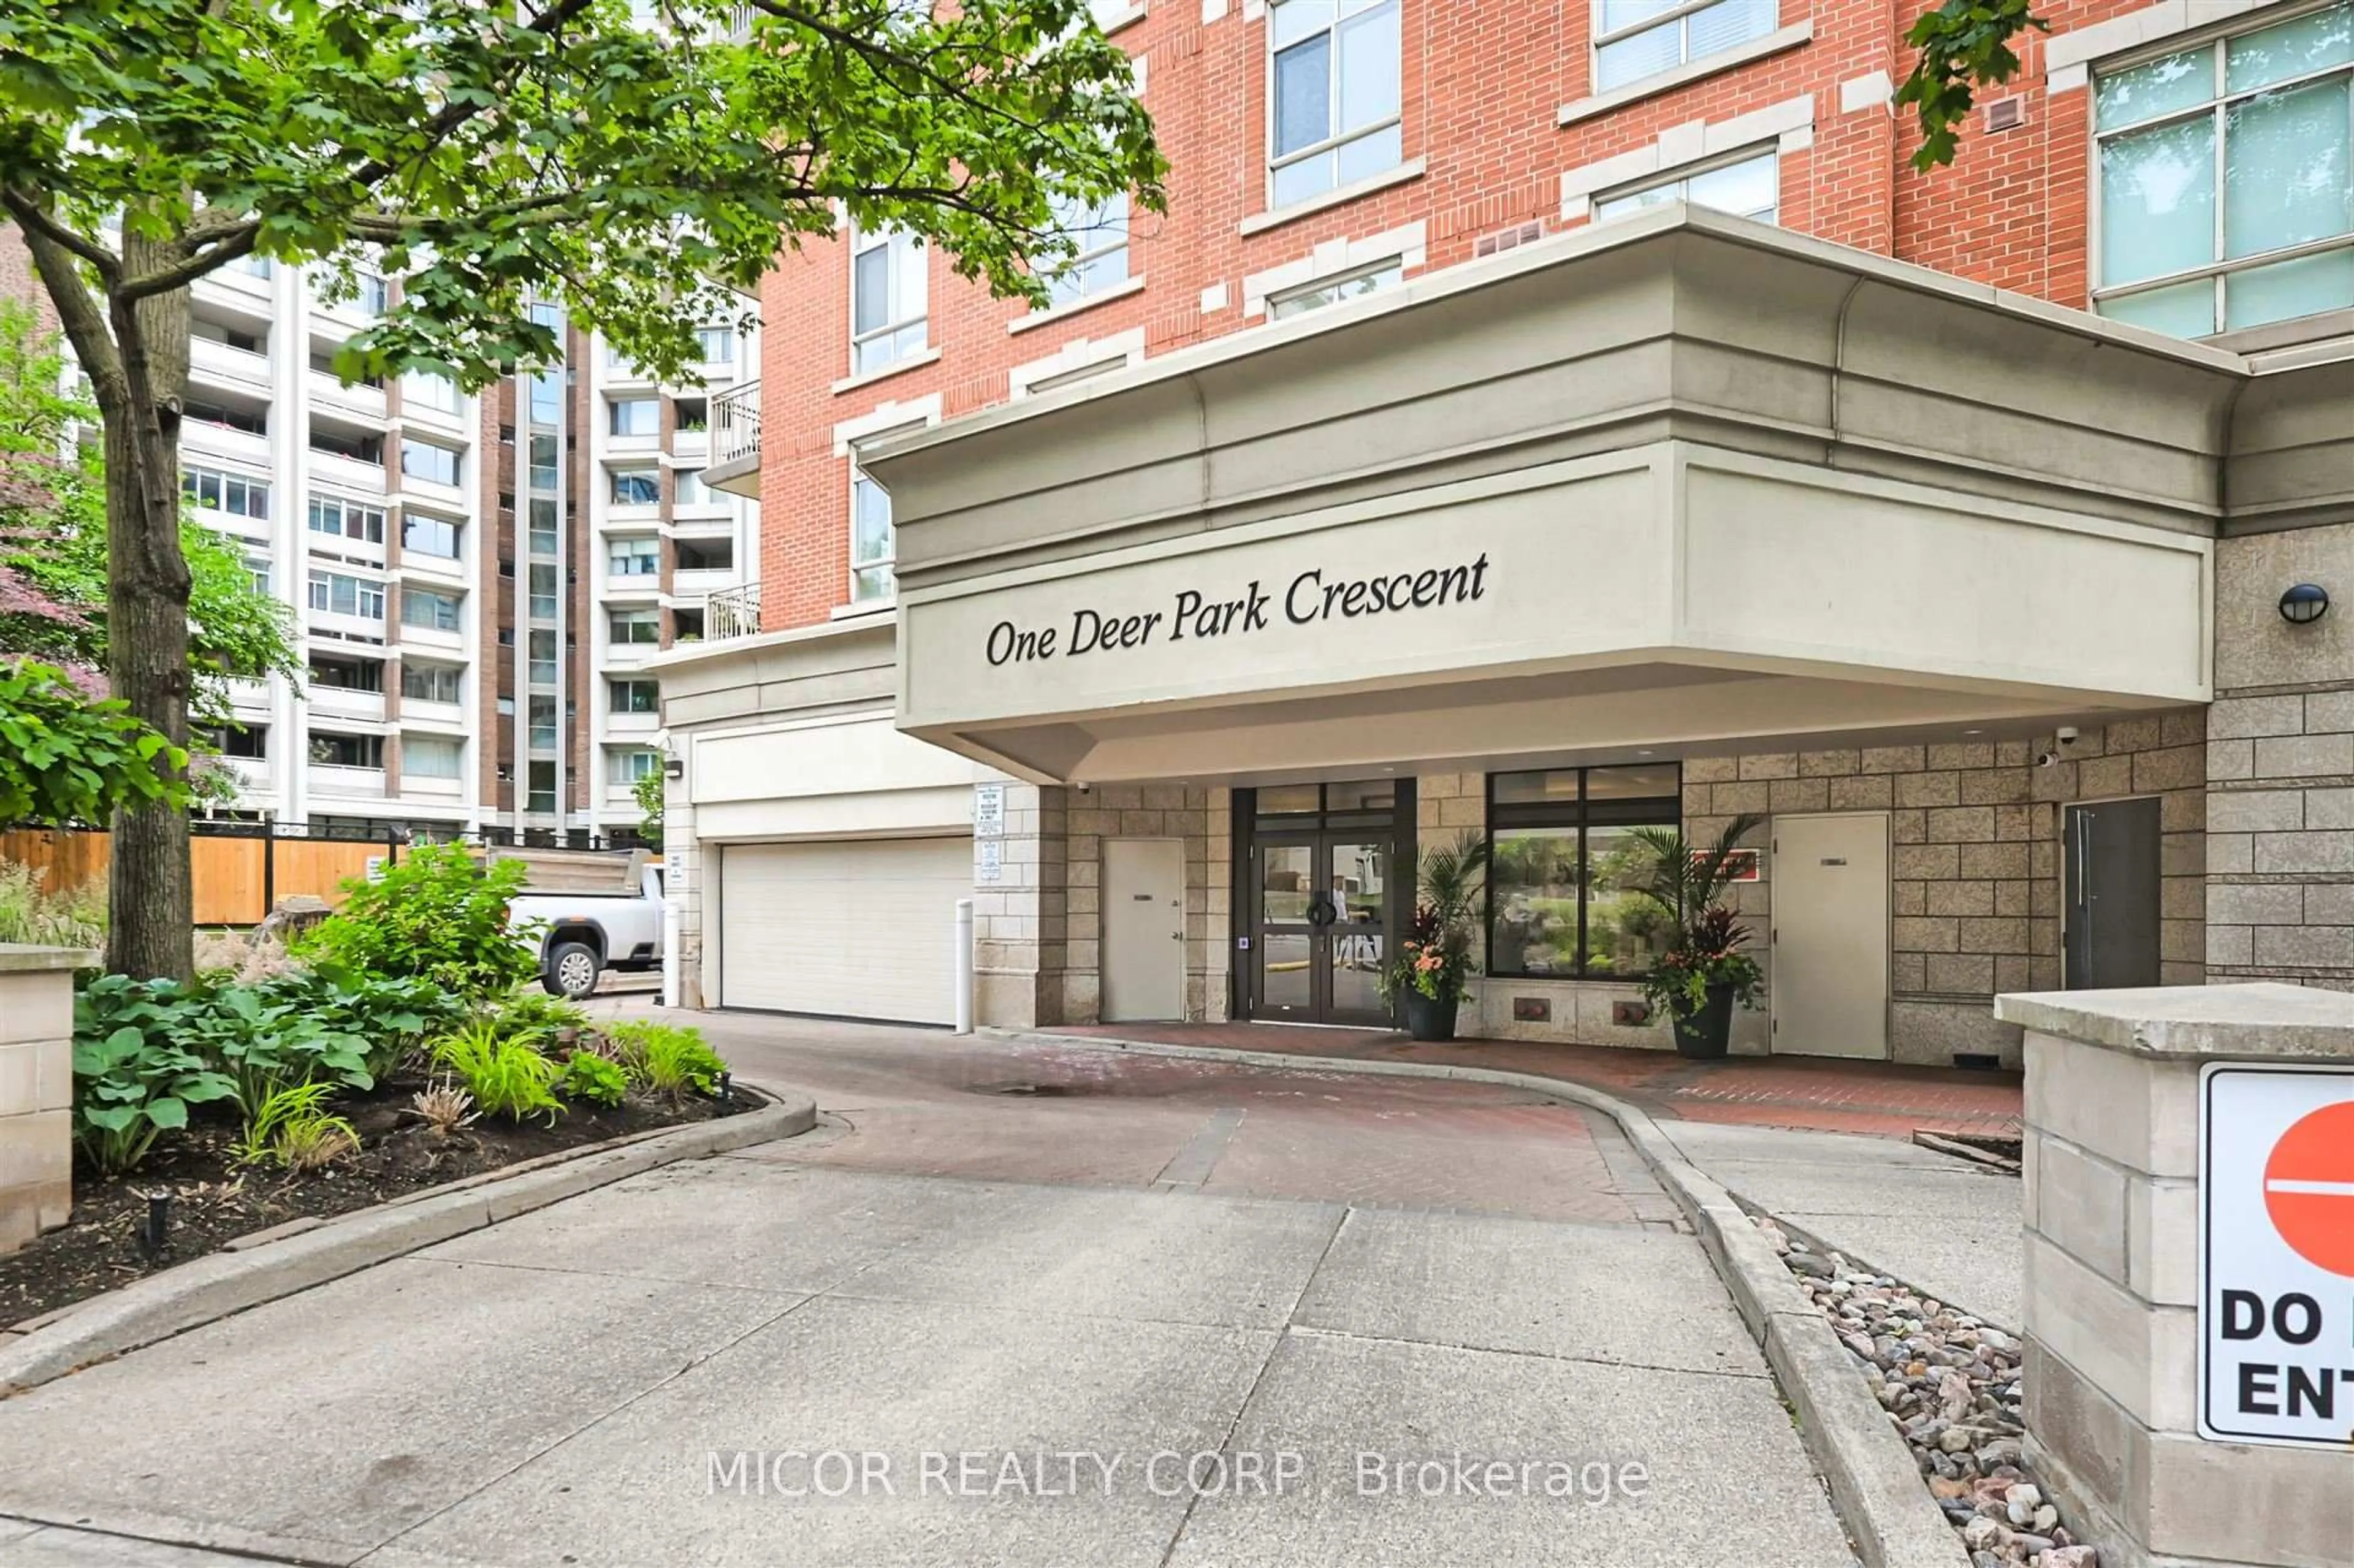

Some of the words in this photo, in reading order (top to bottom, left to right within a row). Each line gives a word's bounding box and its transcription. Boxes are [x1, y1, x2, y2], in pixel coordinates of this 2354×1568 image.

[986, 621, 1056, 666] One
[1066, 609, 1162, 657] Deer
[1169, 580, 1271, 641] Park
[1285, 552, 1490, 625] Crescent
[2222, 1289, 2322, 1345] DO
